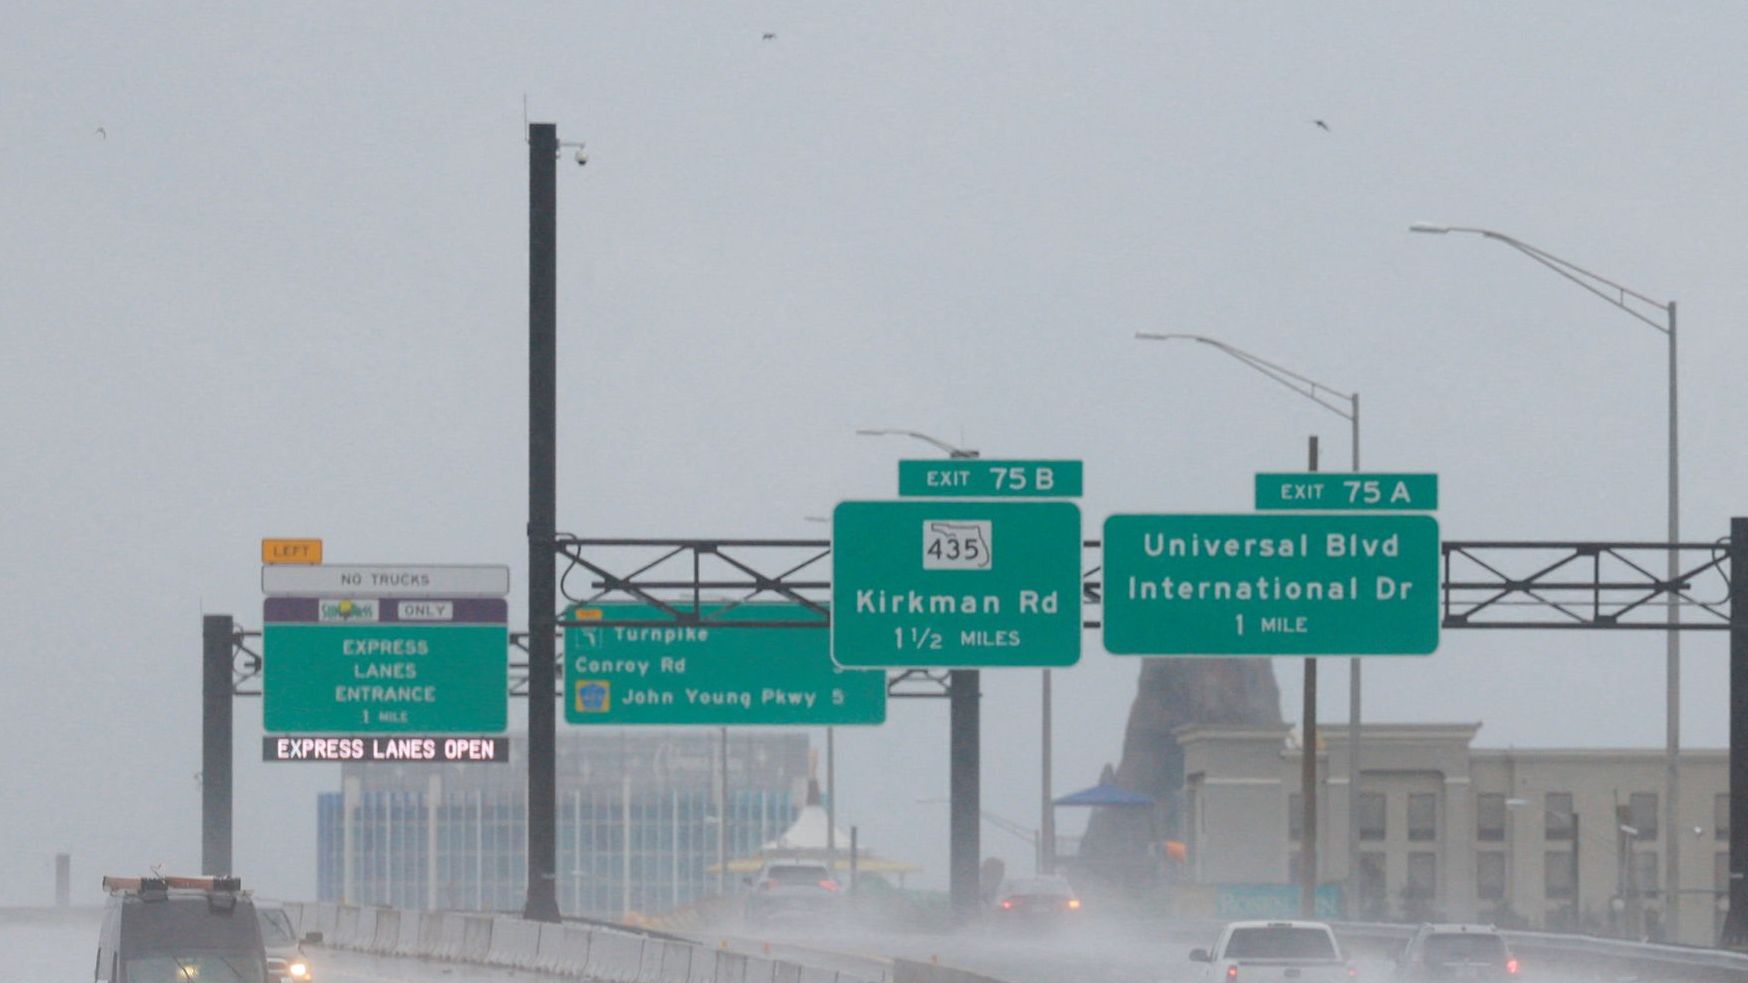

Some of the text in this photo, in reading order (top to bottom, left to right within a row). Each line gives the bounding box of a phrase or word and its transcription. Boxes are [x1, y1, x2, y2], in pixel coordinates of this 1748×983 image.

[926, 467, 1054, 490] EXIT 75 B
[1281, 481, 1411, 503] EXIT 75 A
[273, 545, 310, 558] LEFT
[927, 538, 979, 560] 435
[1144, 533, 1399, 557] Universal Blvd
[341, 573, 430, 587] NO TRUCKS
[1128, 576, 1412, 600] International Dr
[404, 605, 446, 617] ONLY
[856, 590, 1058, 614] Kirkman Rd
[1235, 613, 1308, 635] 1 MILE
[613, 626, 709, 643] Turnpike
[961, 630, 1021, 647] MILES
[342, 639, 429, 656] EXPRESS
[354, 662, 417, 679] LANES
[575, 656, 686, 675] Conroy Rd
[335, 685, 437, 702] ENTRANCE
[621, 689, 674, 705] John
[686, 689, 752, 708] Young
[761, 689, 817, 708] Pkwy
[831, 689, 844, 705] 5
[379, 711, 408, 723] MILE
[276, 739, 494, 759] EXPRESS LANES OPEN
